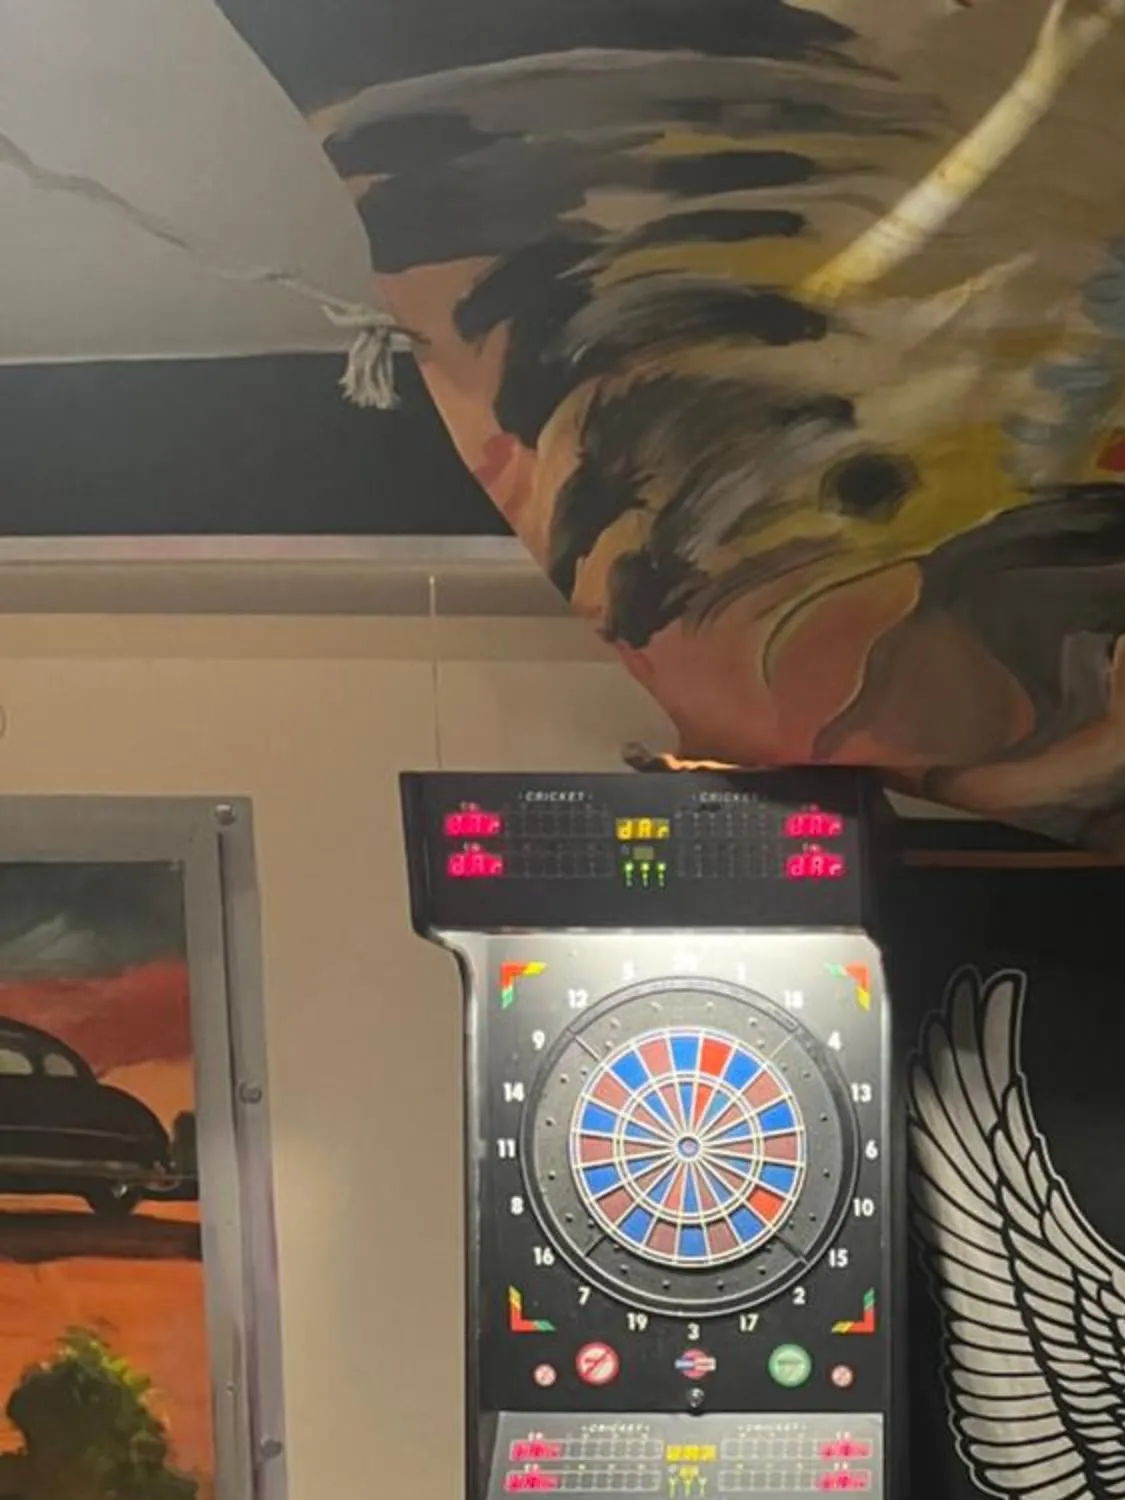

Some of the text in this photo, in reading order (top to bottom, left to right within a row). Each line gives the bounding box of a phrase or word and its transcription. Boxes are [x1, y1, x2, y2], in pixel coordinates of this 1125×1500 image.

[532, 1029, 546, 1049] 9
[827, 1031, 841, 1050] 4
[503, 1082, 525, 1102] 14
[851, 1082, 872, 1102] 13
[497, 1139, 515, 1158] 11
[865, 1140, 878, 1159] 6
[511, 1196, 524, 1215] 8
[853, 1198, 875, 1217] 10
[533, 1247, 555, 1265] 16
[829, 1248, 848, 1268] 15
[579, 1286, 590, 1305] 7
[793, 1286, 805, 1305] 2
[627, 1312, 648, 1330] 19
[740, 1313, 759, 1331] 17
[688, 1323, 700, 1340] 3
